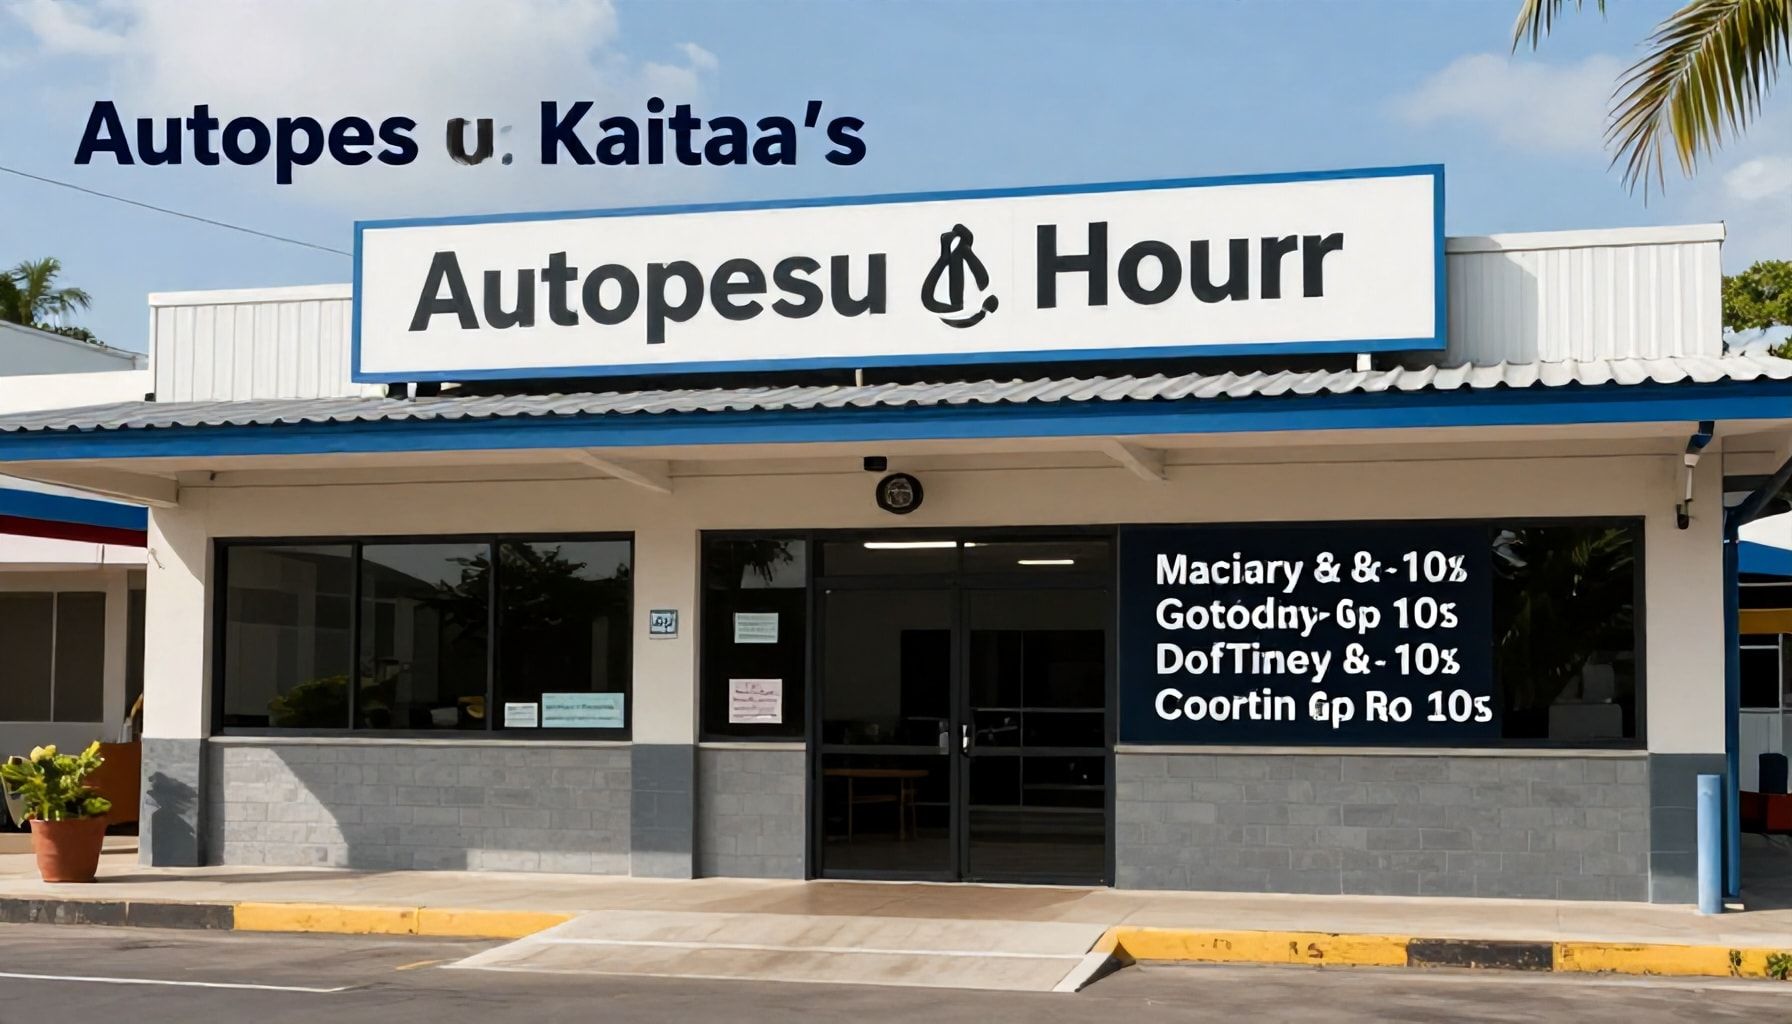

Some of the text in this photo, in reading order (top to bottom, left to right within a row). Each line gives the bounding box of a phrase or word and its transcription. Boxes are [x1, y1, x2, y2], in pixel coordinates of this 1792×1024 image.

[408, 251, 887, 345] Autopesu
[1036, 221, 1344, 309] Hourr
[1156, 551, 1304, 594] Maciary
[1313, 551, 1341, 584] &
[1154, 687, 1296, 722] Coortin
[1365, 690, 1413, 723] Ro
